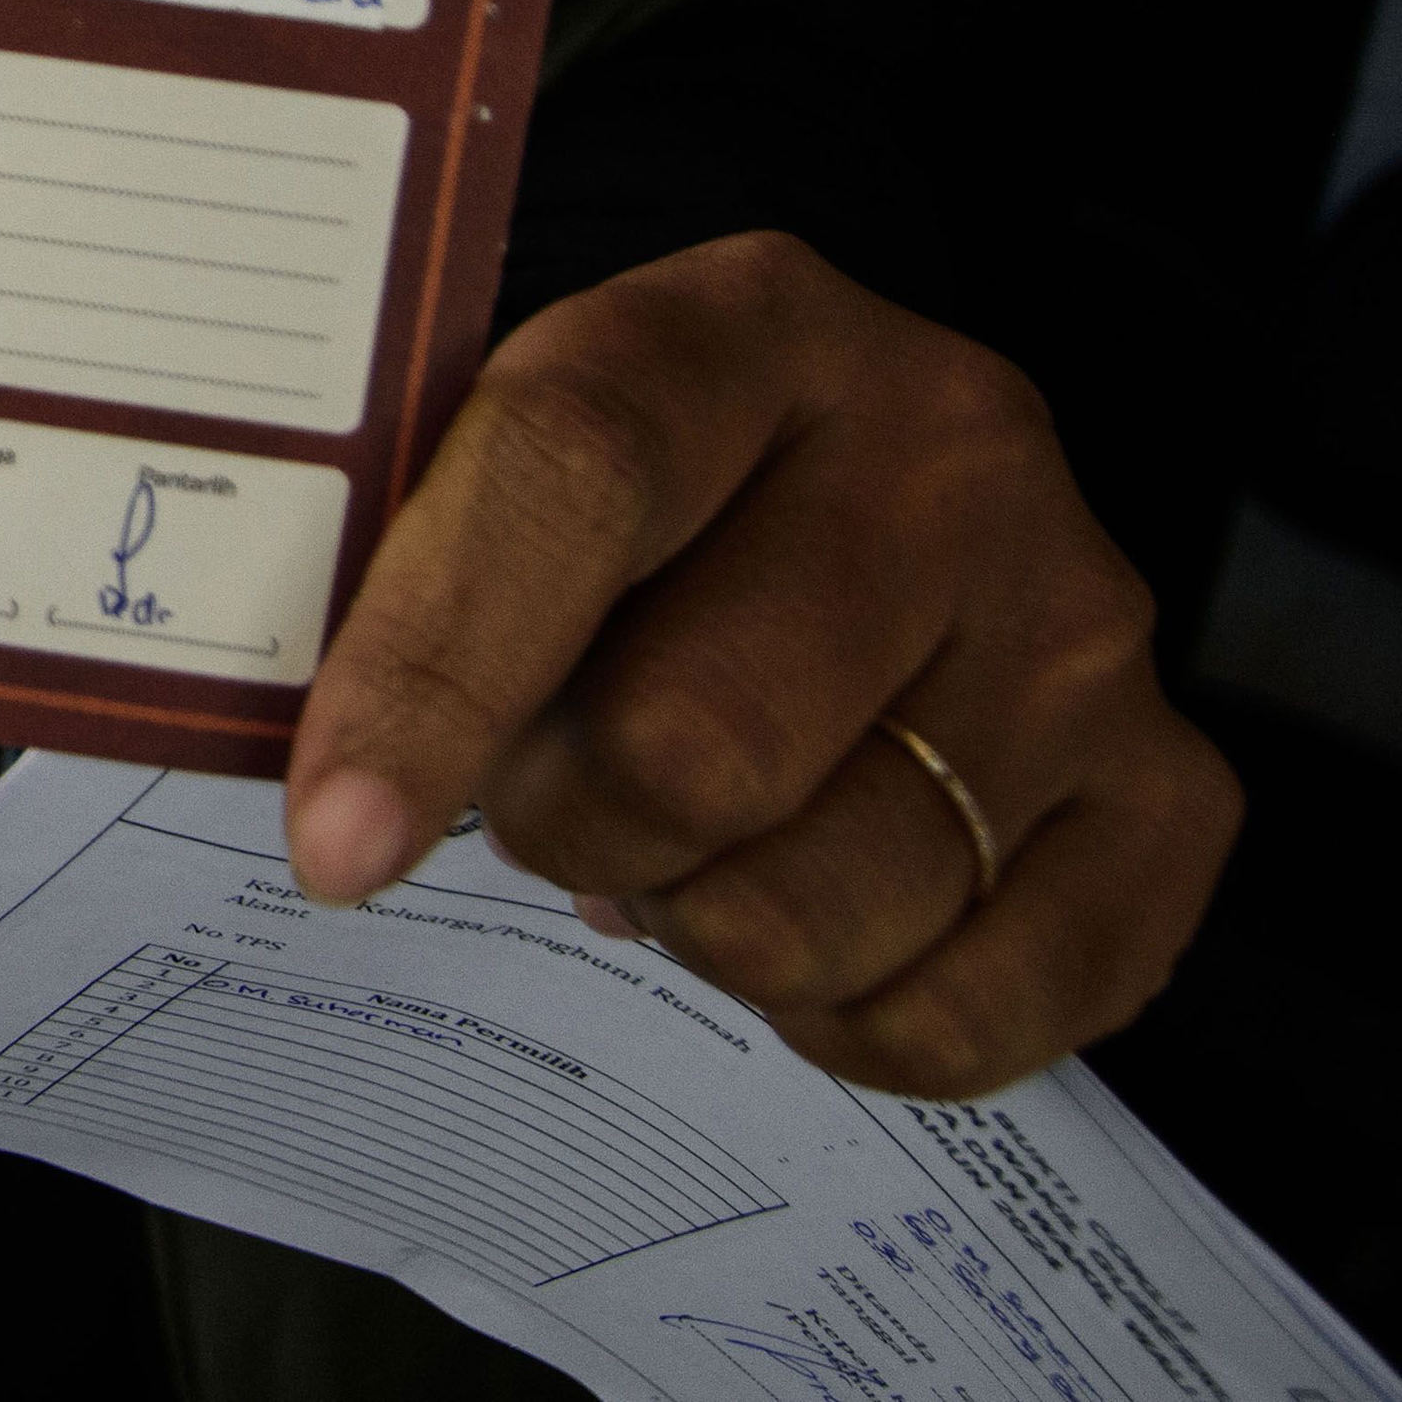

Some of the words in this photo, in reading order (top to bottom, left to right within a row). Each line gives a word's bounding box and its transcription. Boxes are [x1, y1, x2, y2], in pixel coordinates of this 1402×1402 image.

[184, 922, 224, 939] No
[233, 933, 287, 951] TPS
[137, 980, 156, 990] 2
[162, 952, 202, 969] No
[366, 993, 449, 1022] Nama
[118, 991, 139, 1003] 3
[104, 1004, 120, 1015] 4
[649, 984, 752, 1054] Rumah
[84, 1016, 101, 1027] 5
[68, 1028, 85, 1039] 6
[54, 1040, 72, 1050] 7
[35, 1052, 55, 1064] 8
[21, 1064, 39, 1075] 9
[1, 1075, 31, 1088] 10
[991, 1109, 1081, 1204] BUKTI
[902, 1101, 992, 1190] AHUN
[992, 1199, 1064, 1270] 2024
[991, 1137, 1080, 1240] WAKIL
[962, 1137, 1028, 1201] DAN
[1027, 1207, 1113, 1309] WAKIL
[816, 1267, 919, 1365] Tanggal
[836, 1265, 937, 1363] Ditanda
